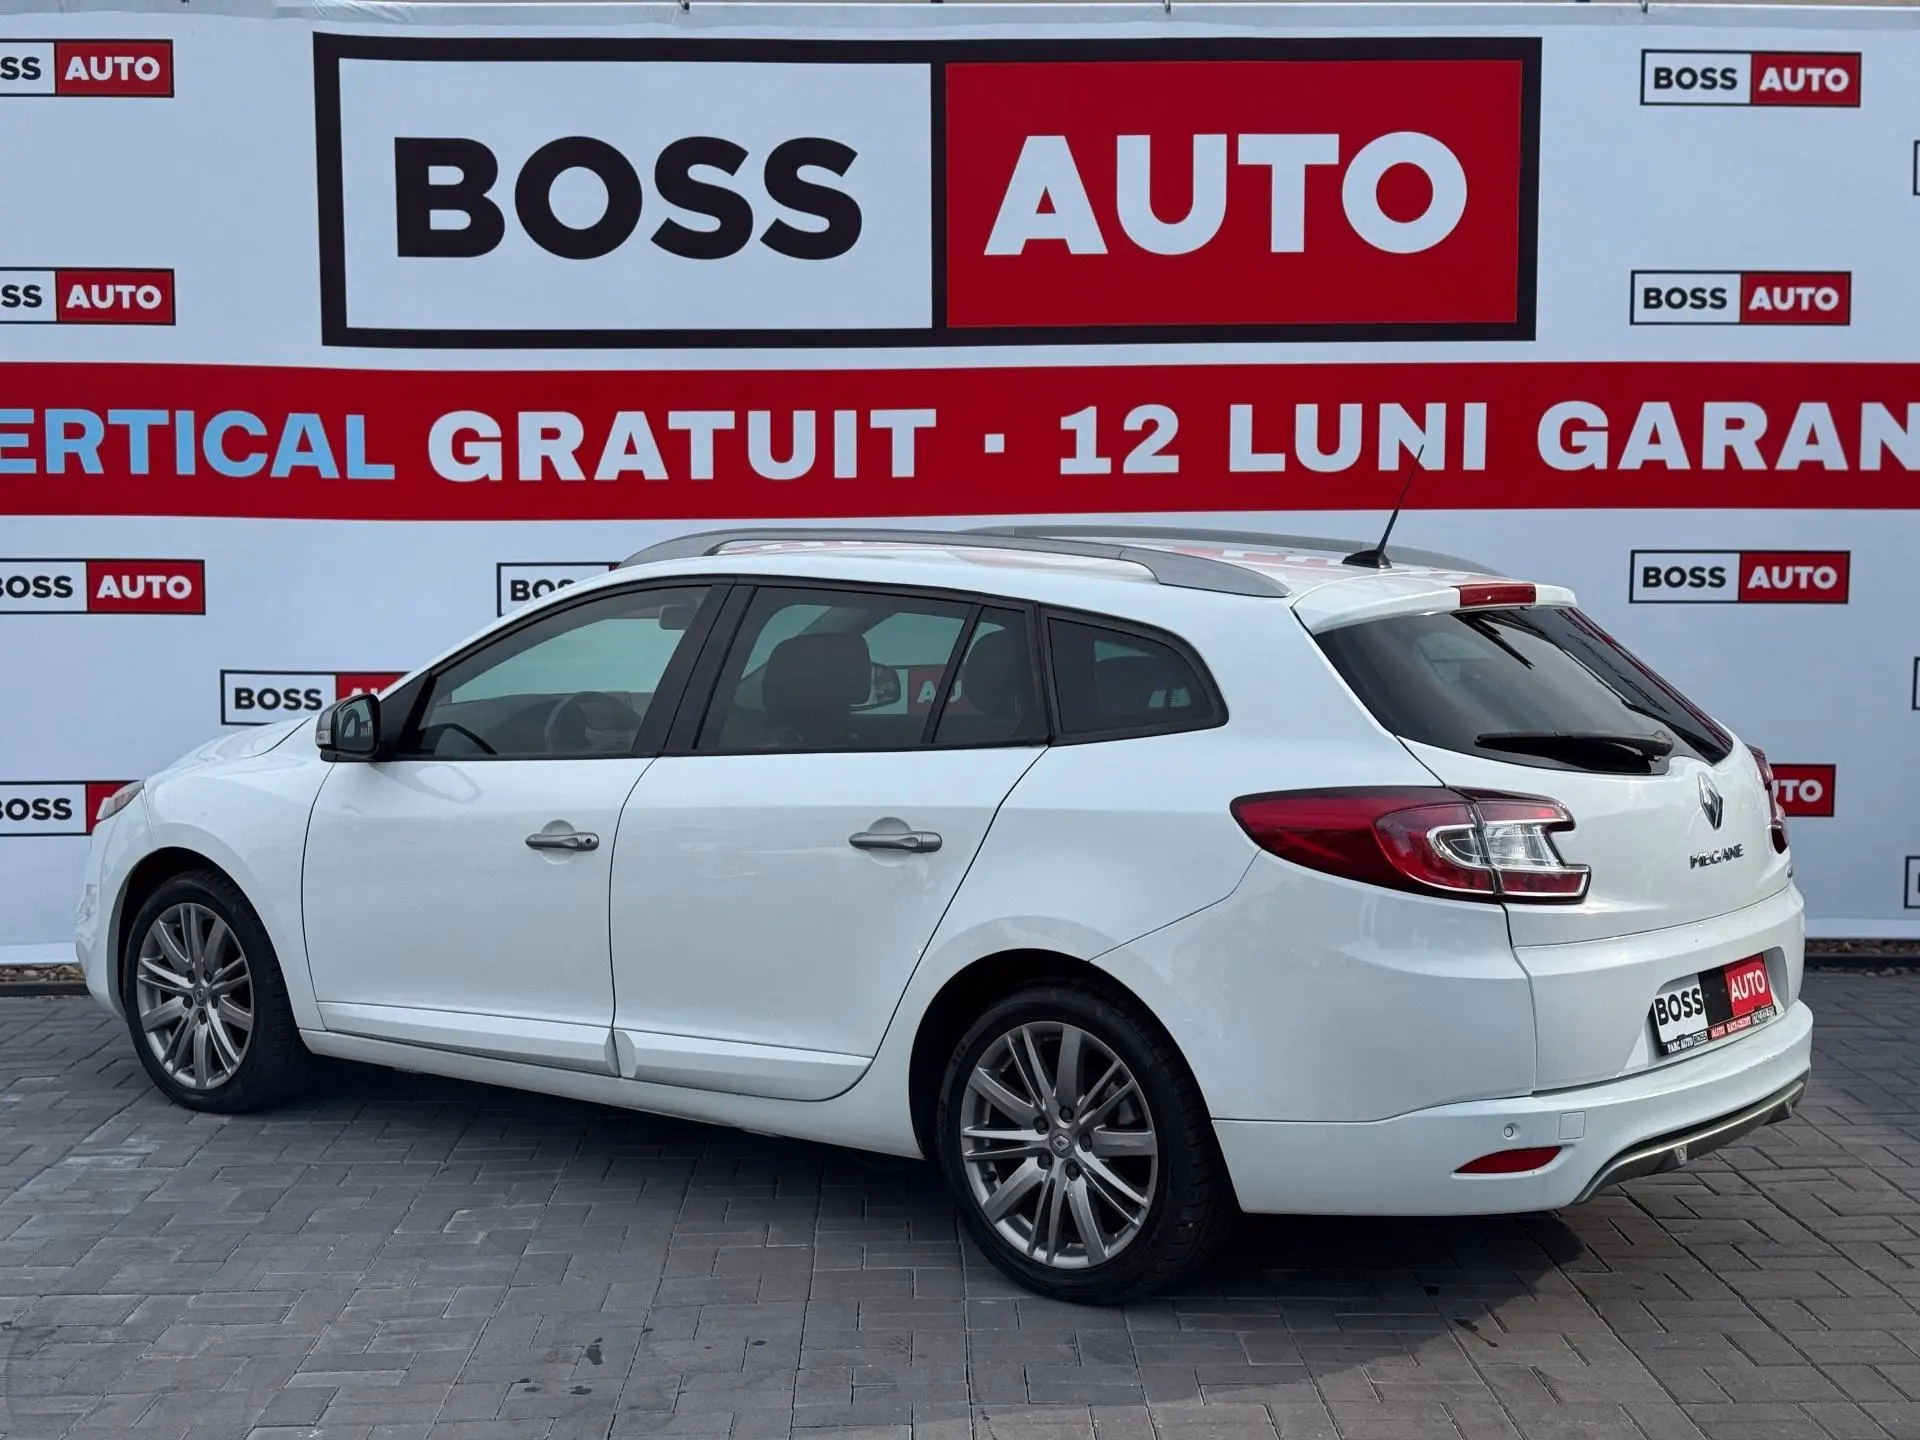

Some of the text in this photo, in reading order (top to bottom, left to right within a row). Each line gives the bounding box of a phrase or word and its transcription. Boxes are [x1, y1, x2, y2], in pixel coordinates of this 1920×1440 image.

[65, 57, 160, 81] AUTO
[1654, 67, 1849, 92] BOSS AUTO
[395, 132, 1467, 260] BOSS AUTO
[66, 285, 161, 309] AUTO
[1643, 287, 1839, 311] BOSS AUTO
[428, 409, 936, 482] GRATUIT
[1060, 404, 1179, 474] 12
[1230, 403, 1487, 472] LUNI
[0, 575, 192, 599] OSS AUTO
[1643, 566, 1838, 590] BOSS AUTO
[235, 688, 322, 711] BOSS
[0, 798, 72, 821] OSS
[1690, 844, 1744, 869] MEGANE
[1655, 988, 1704, 1026] BOSS
[1731, 969, 1766, 1003] AUTO
